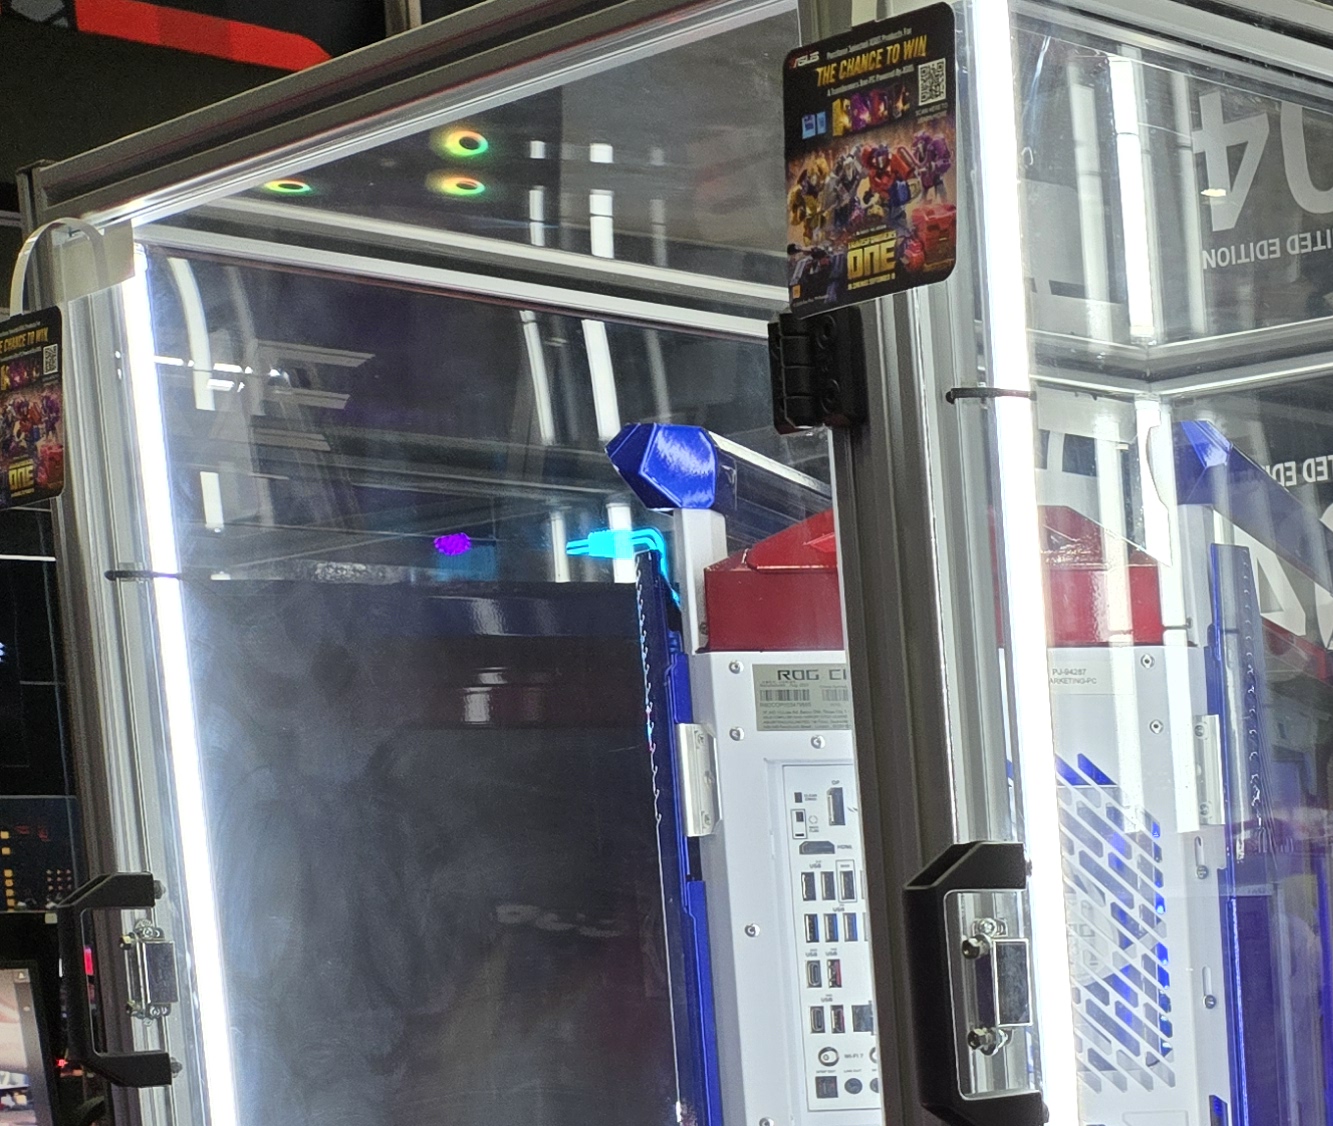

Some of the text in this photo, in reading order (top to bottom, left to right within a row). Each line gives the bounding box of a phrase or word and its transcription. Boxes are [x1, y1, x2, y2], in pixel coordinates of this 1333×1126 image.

[815, 65, 839, 87] THE
[839, 48, 883, 80] CHANCE
[886, 43, 900, 64] TO
[903, 35, 928, 60] WIN
[847, 238, 897, 280] ONE
[1202, 237, 1281, 270] EDITION
[777, 669, 819, 681] ROG
[1050, 677, 1097, 685] ARKETING-PC
